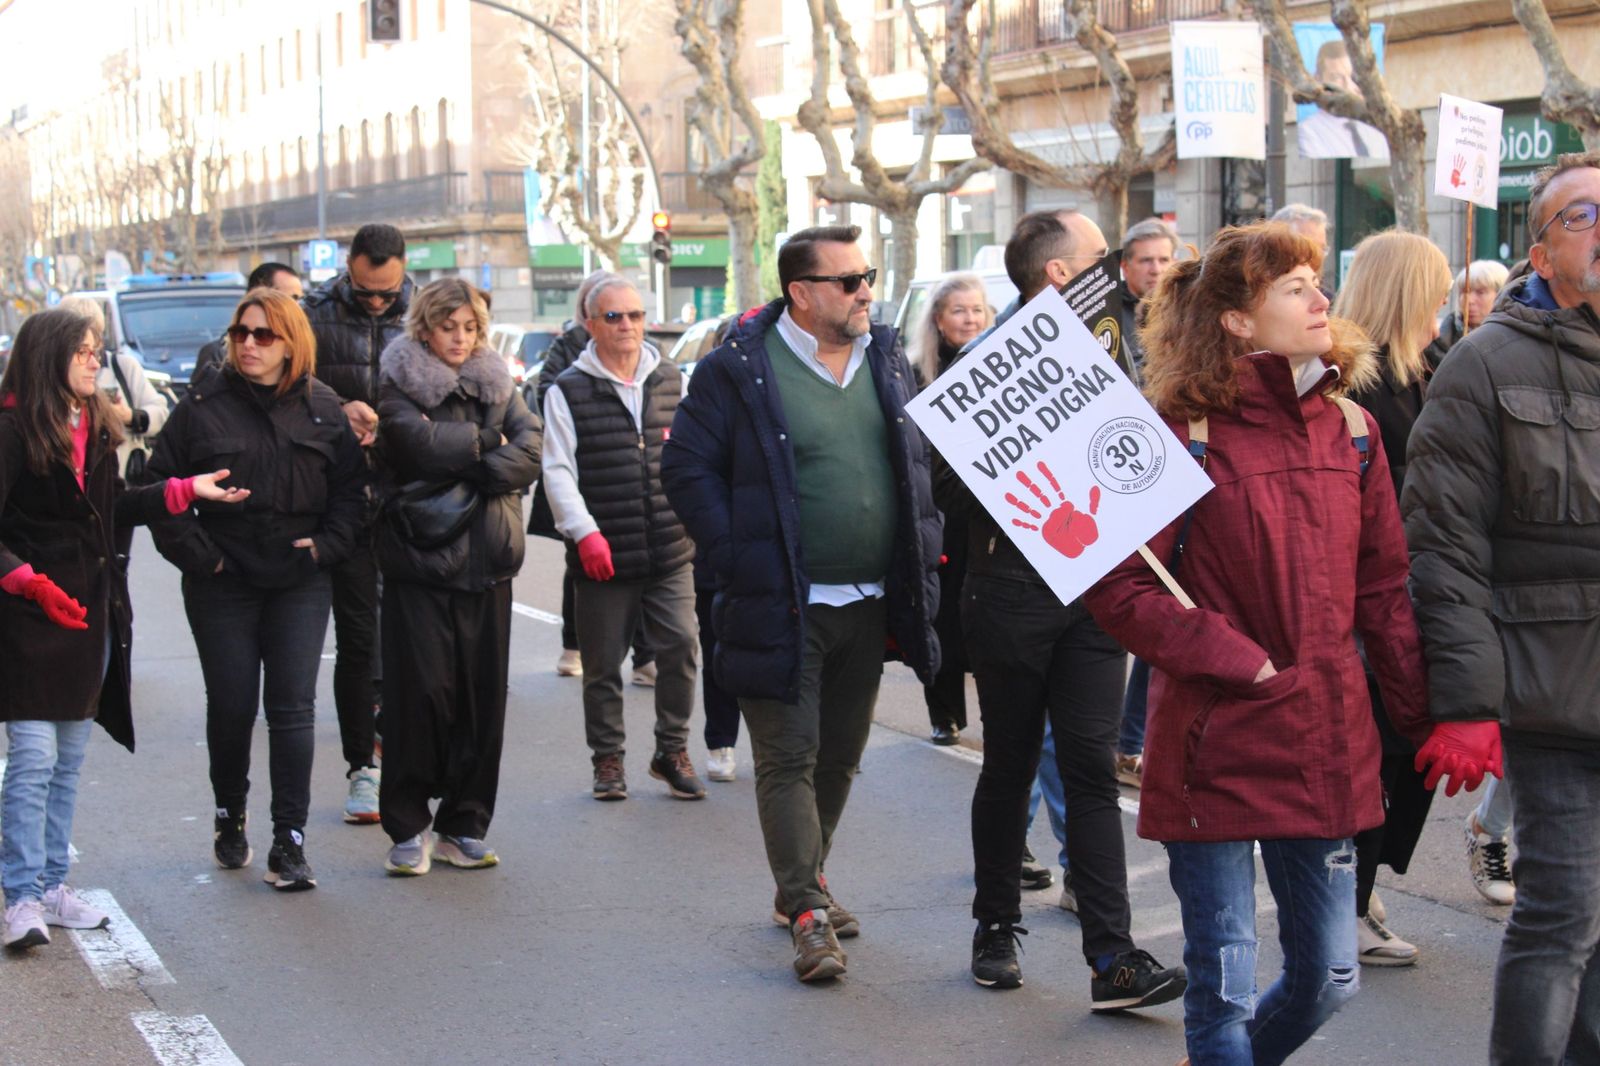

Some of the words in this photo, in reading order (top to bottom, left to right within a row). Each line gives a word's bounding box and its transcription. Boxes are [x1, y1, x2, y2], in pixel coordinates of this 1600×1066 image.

[1184, 81, 1256, 114] CERTEZAS
[314, 243, 333, 266] P
[1095, 266, 1104, 278] DE
[1071, 274, 1109, 307] JUBILACIONES
[929, 312, 1060, 423] TRABAJO
[972, 356, 1076, 438] DIGNO,
[972, 424, 1042, 481] VIDA
[1035, 363, 1116, 433] DIGNA
[1115, 421, 1147, 432] NACIONAL
[1105, 435, 1140, 468] 30
[1128, 459, 1145, 476] N
[1121, 483, 1131, 491] DE
[1113, 967, 1136, 989] N
